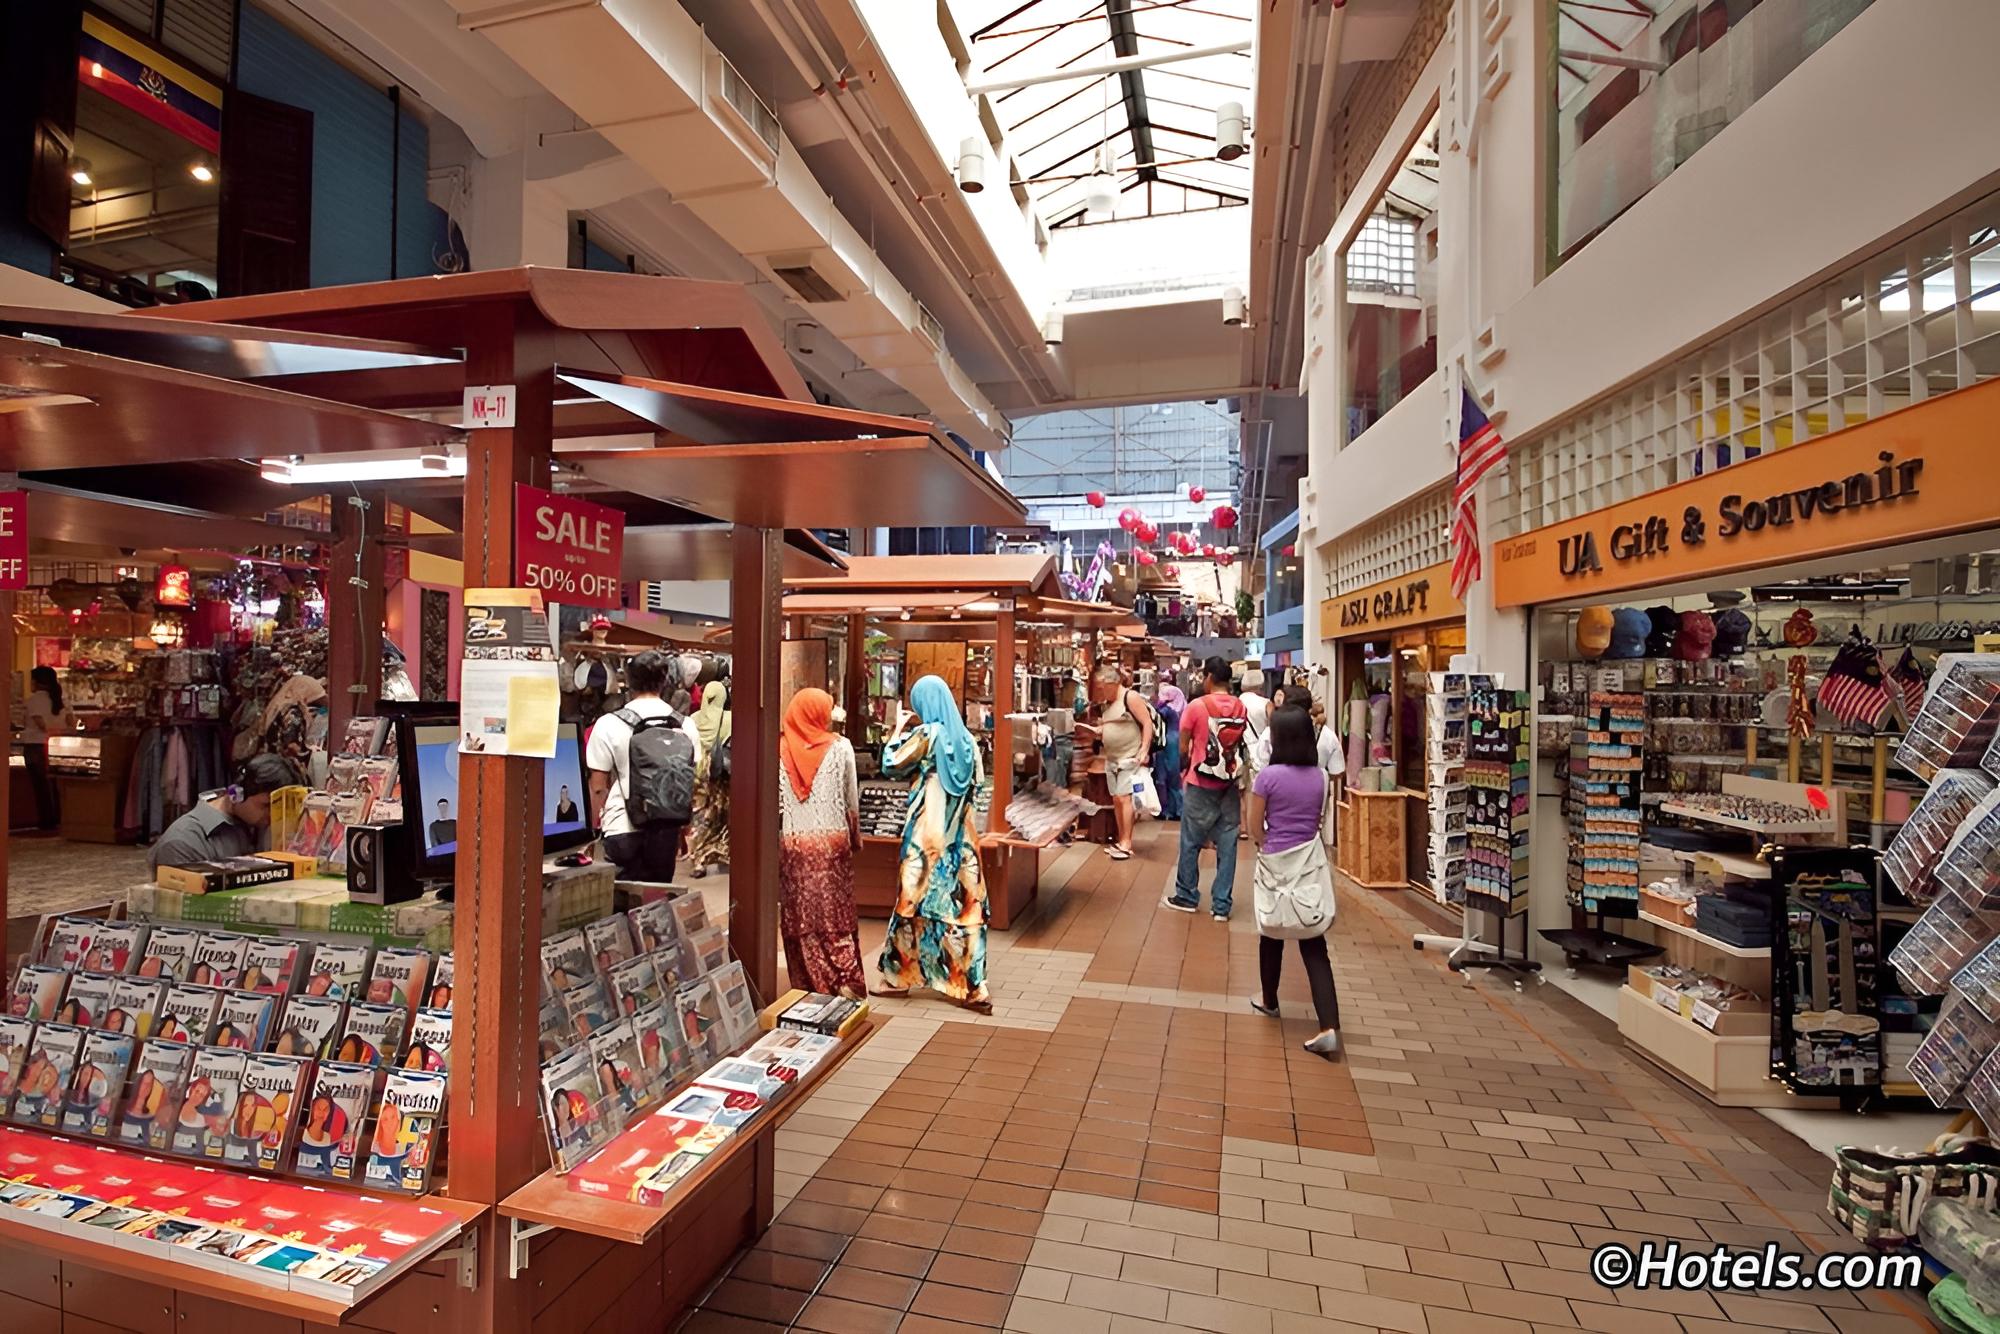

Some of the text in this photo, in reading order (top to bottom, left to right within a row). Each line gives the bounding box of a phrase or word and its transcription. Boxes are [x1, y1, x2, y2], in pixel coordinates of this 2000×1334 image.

[536, 506, 611, 554] SALE
[1557, 531, 1603, 576] UA
[1610, 515, 1669, 560] Gift
[1681, 505, 1705, 545] &
[1719, 450, 1923, 537] Souvenir
[525, 563, 616, 598] 50% OFF
[1374, 580, 1430, 620] CRAFT
